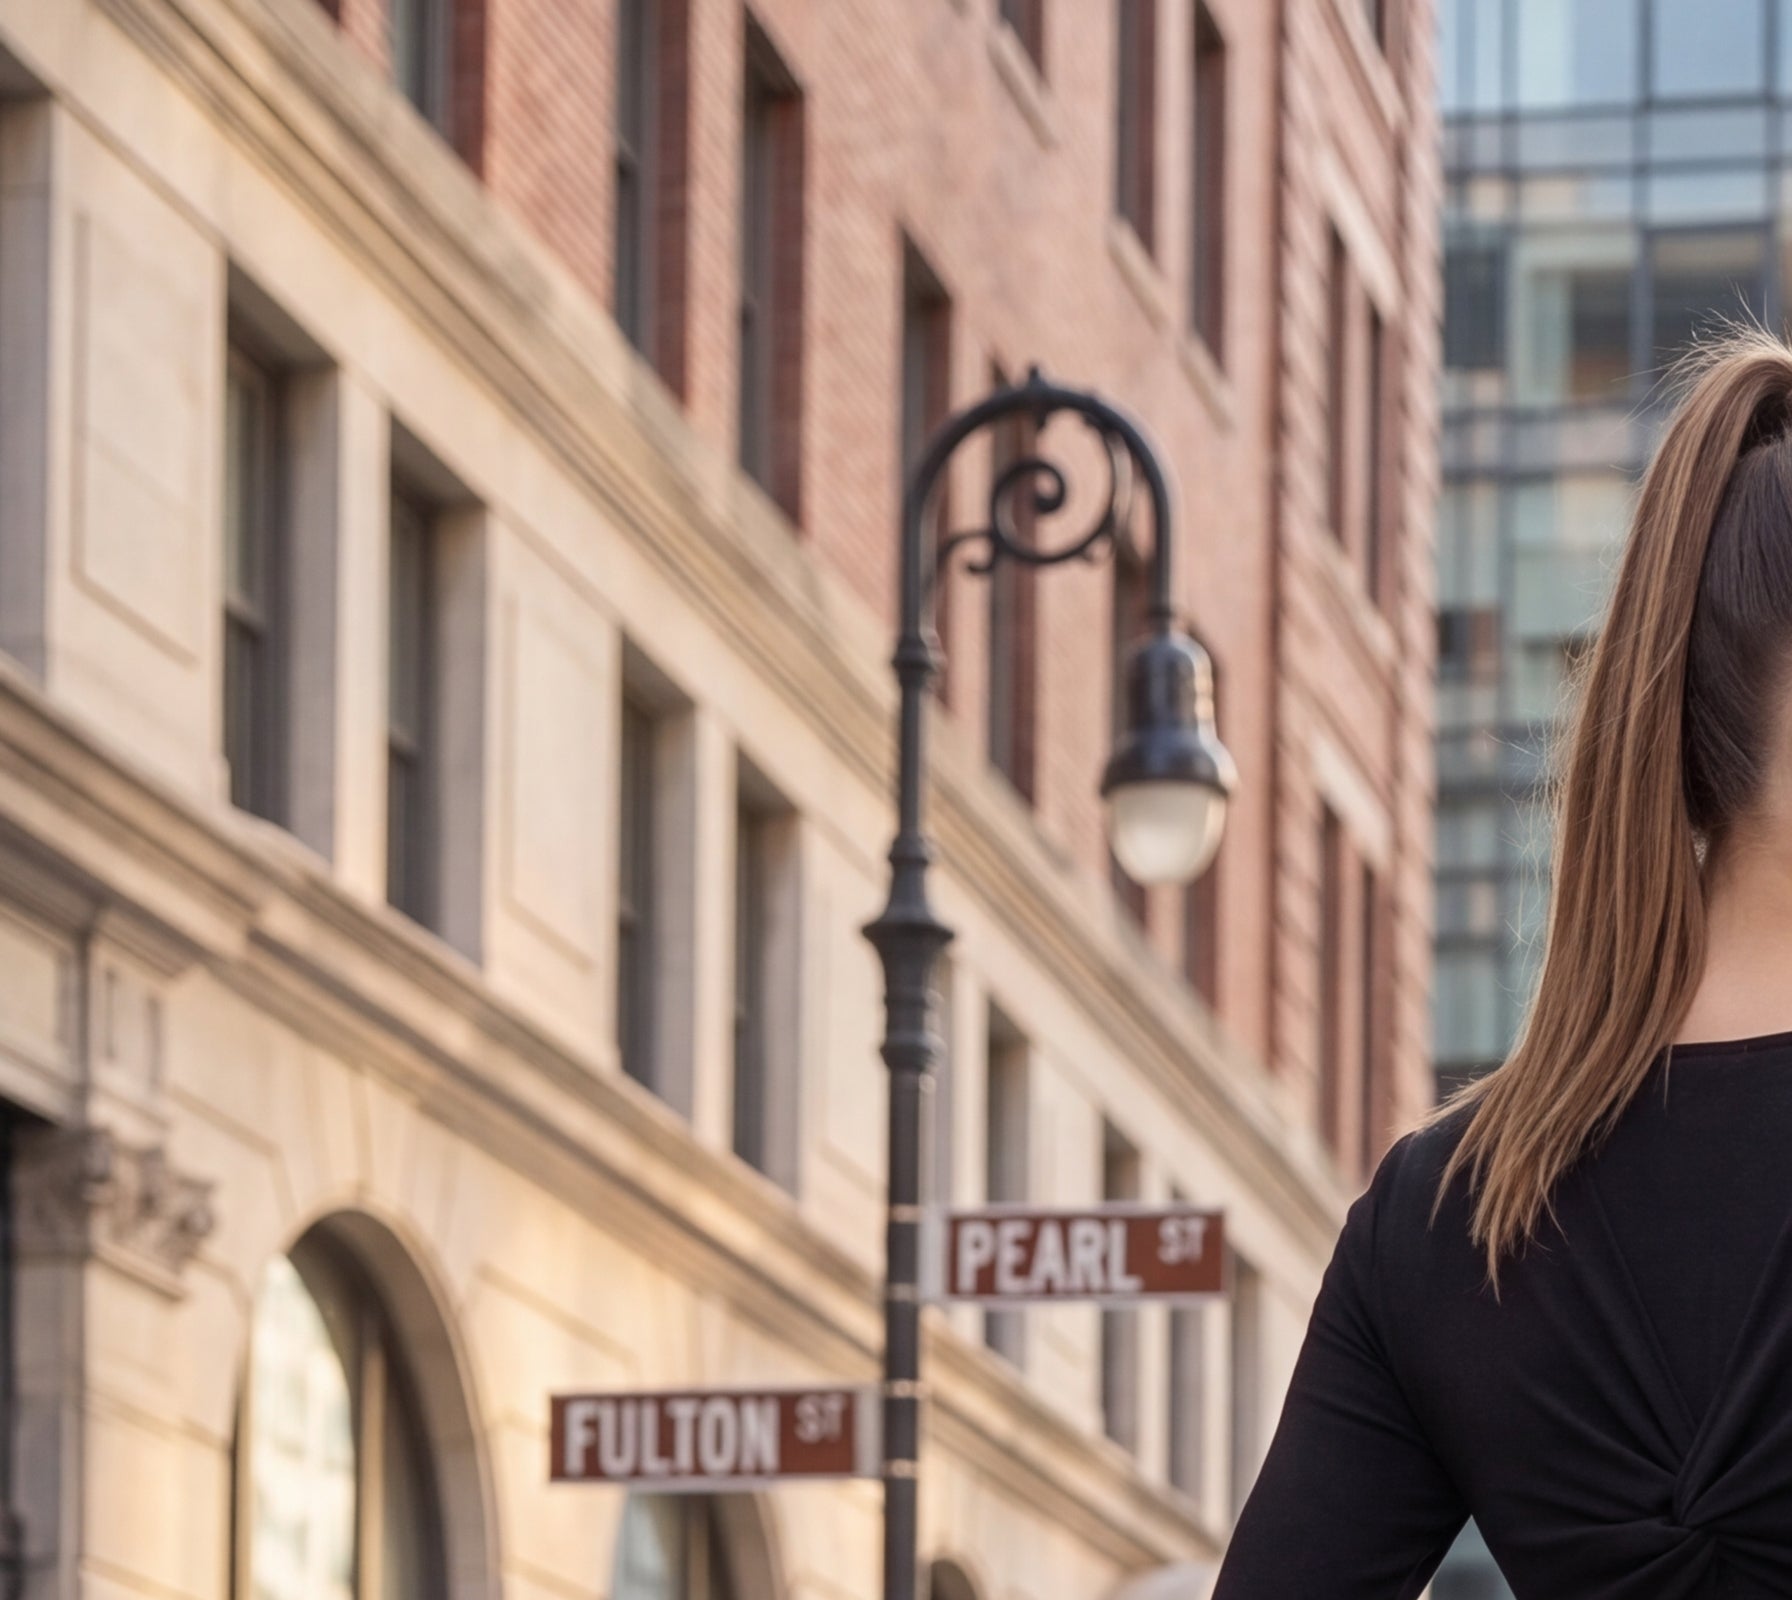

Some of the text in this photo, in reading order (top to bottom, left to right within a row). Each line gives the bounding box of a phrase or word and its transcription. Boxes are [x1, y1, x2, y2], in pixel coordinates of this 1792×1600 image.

[956, 1217, 1208, 1294] PEARL ST
[564, 1395, 846, 1475] FULTON ST
